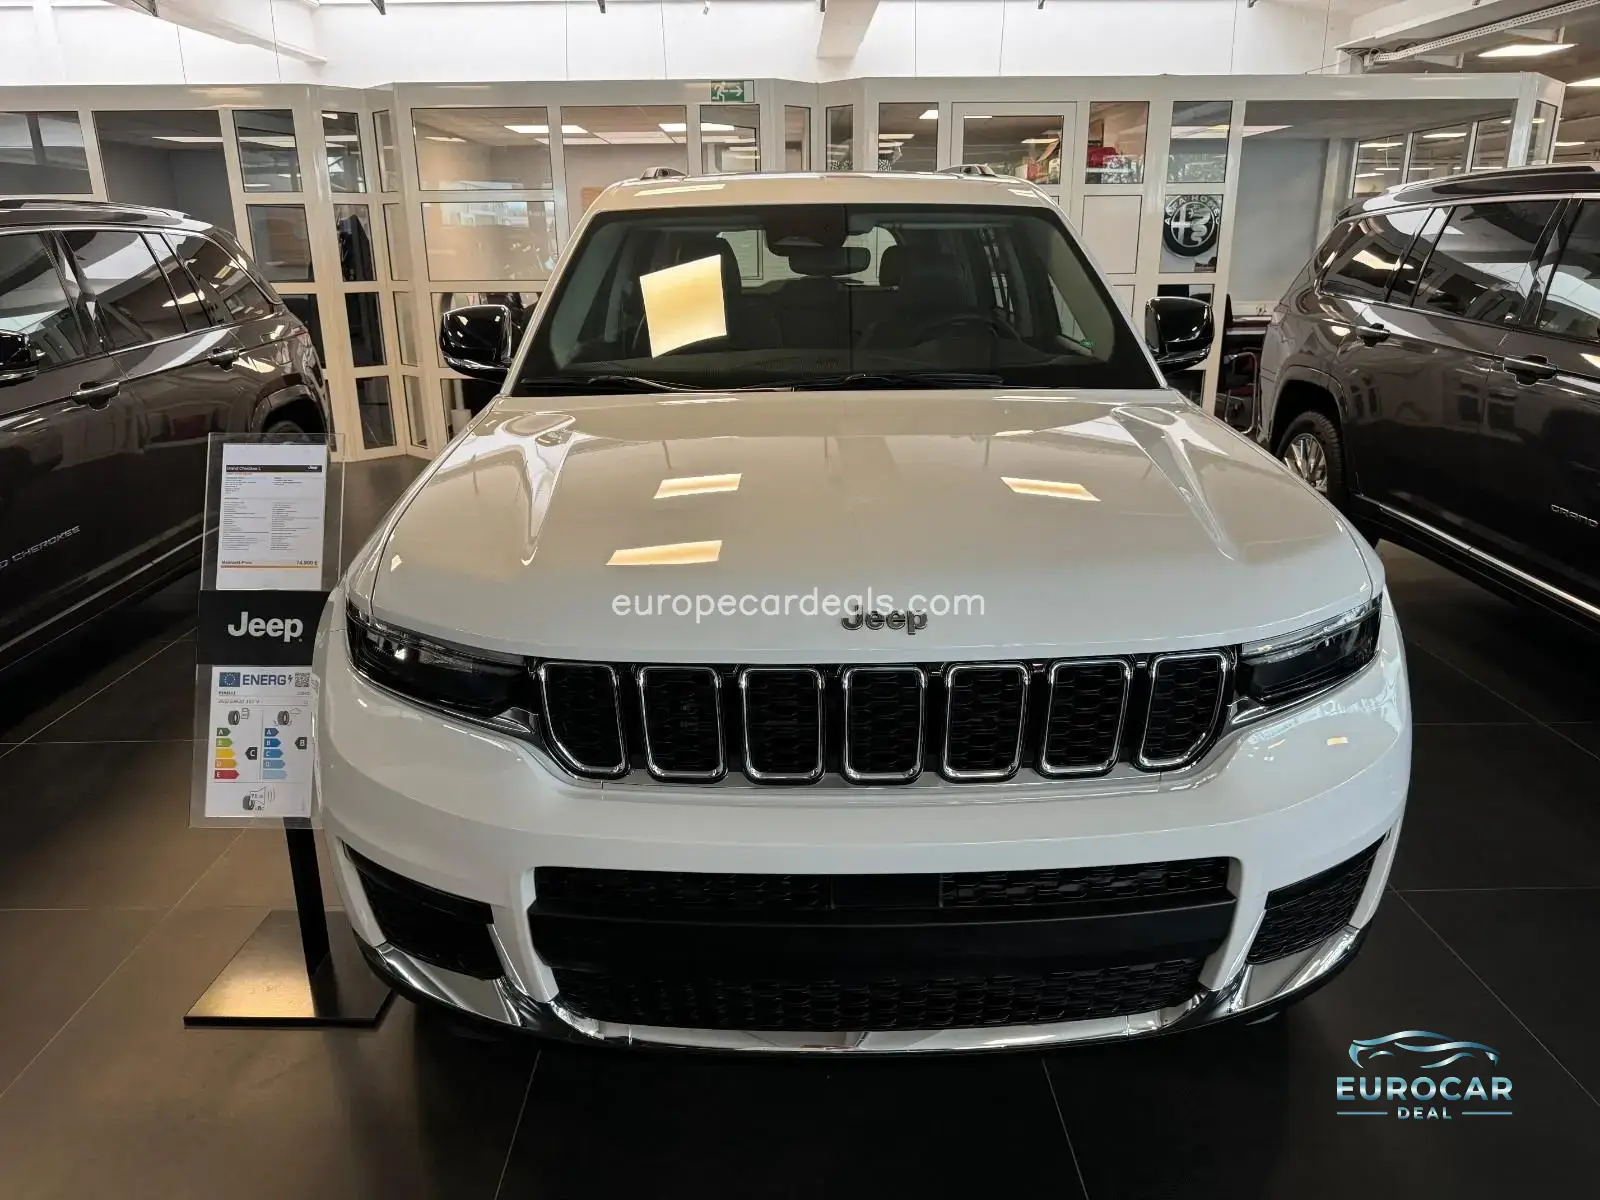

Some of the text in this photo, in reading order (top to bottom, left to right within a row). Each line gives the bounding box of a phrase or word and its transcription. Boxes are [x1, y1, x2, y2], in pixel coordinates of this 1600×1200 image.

[1551, 504, 1599, 528] GRAND
[12, 525, 81, 562] CHEROKEE
[228, 611, 304, 643] Jeep
[841, 605, 928, 636] Jeep
[242, 674, 287, 686] ENERG
